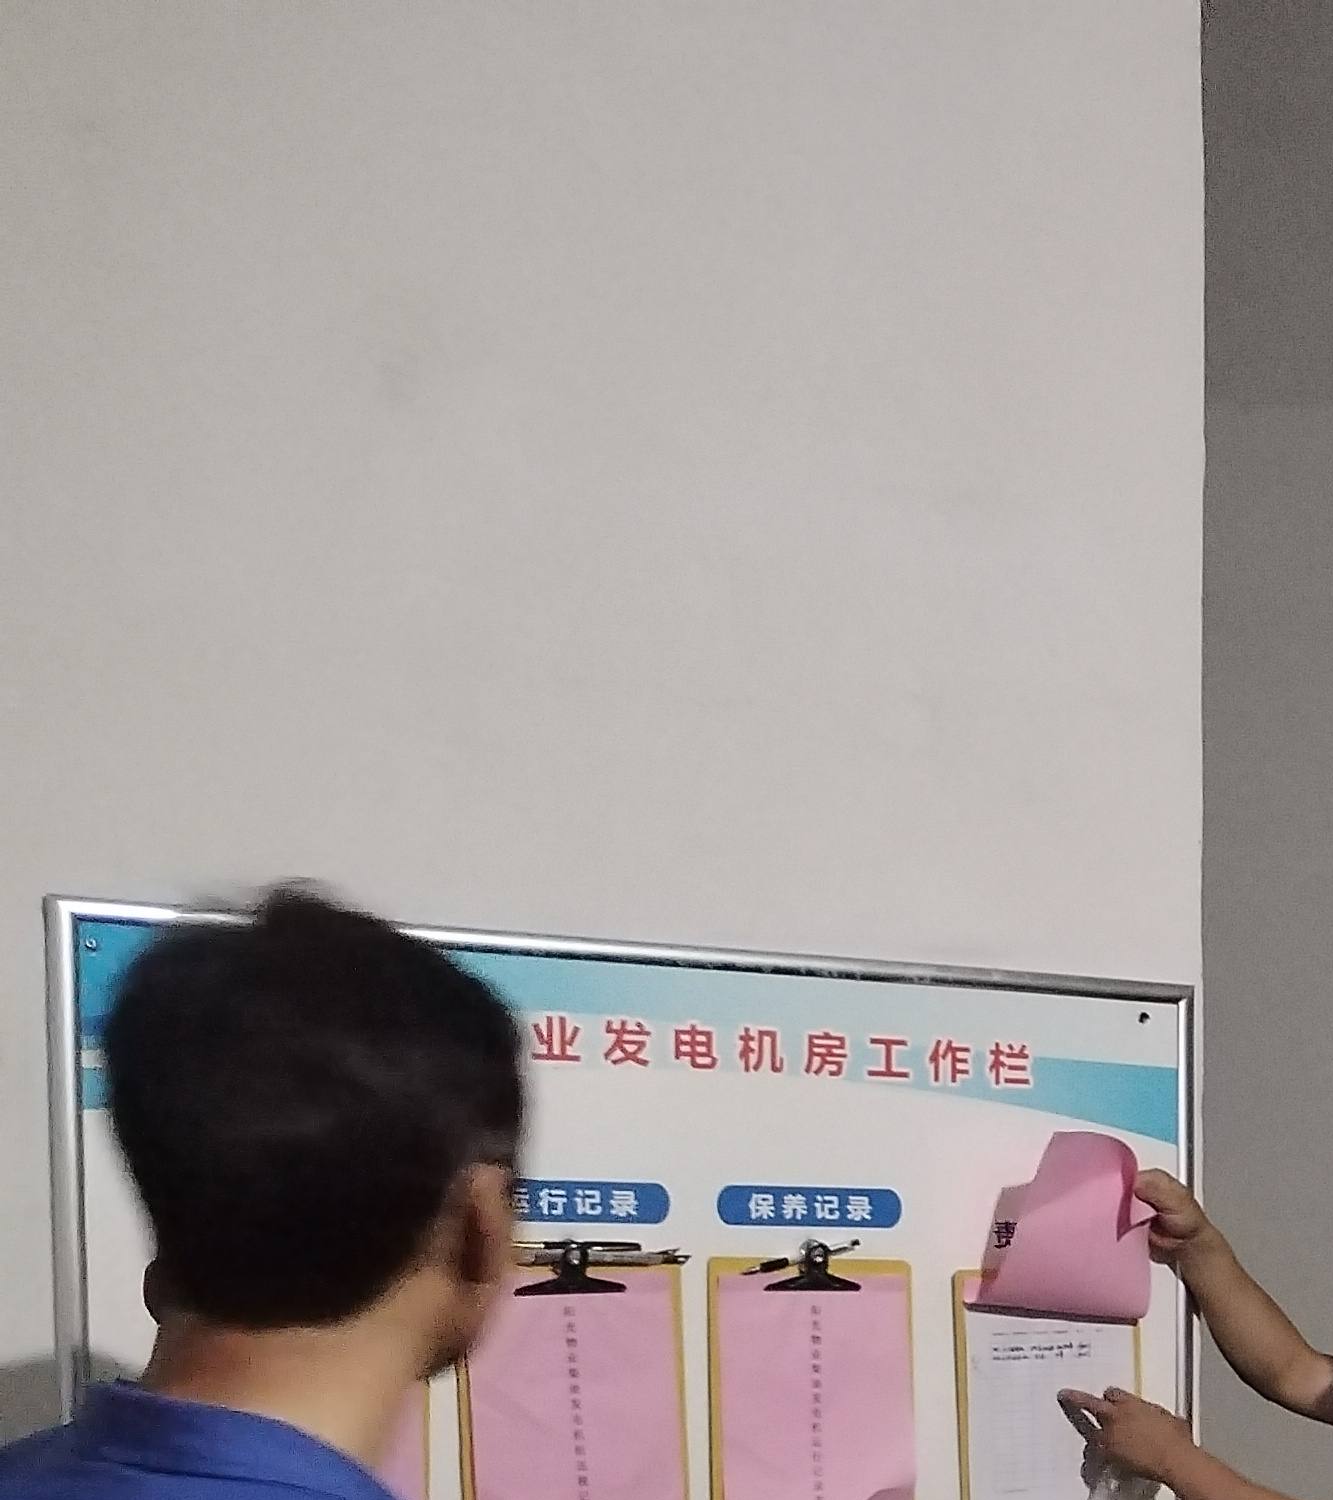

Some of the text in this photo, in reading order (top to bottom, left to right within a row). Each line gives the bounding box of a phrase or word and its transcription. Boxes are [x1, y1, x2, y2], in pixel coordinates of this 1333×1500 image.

[532, 1016, 1031, 1086] 业发电机房工作栏
[749, 1194, 874, 1221] 保养记录
